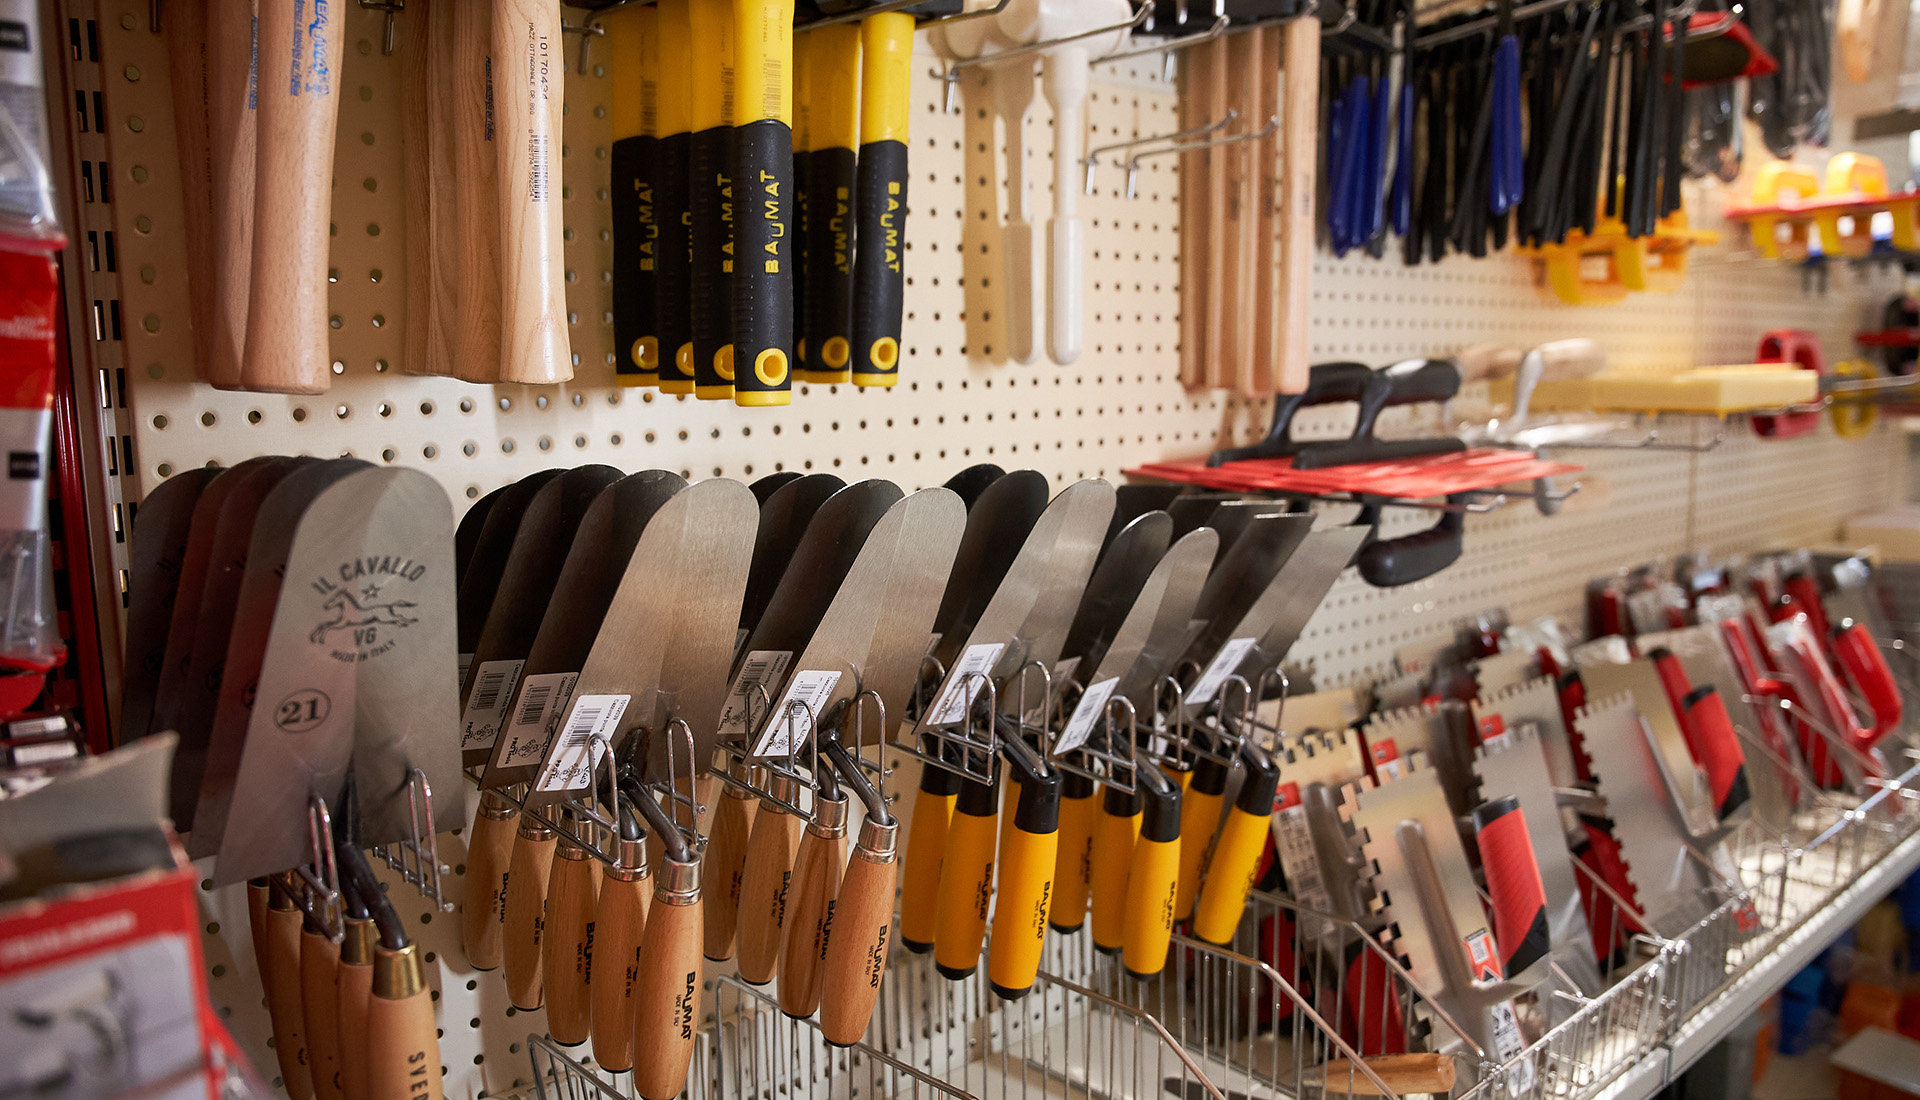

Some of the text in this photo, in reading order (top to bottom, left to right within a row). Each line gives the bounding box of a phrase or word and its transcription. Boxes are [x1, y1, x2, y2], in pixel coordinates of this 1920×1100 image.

[634, 178, 658, 271] BAUMAT
[717, 173, 734, 273] BAMAT
[760, 170, 784, 273] BAUMAT
[829, 186, 849, 275] BAUMAT
[880, 181, 900, 273] BAUMAT
[312, 556, 426, 595] IL CAVALLO
[330, 639, 396, 663] MADE IN ITALY
[354, 627, 377, 646] VG
[281, 698, 320, 725] 21
[777, 870, 791, 928] BAUMA
[979, 862, 992, 920] BAUMAT
[1037, 881, 1050, 939] BAUMAT
[584, 922, 595, 984] BAUMA
[820, 900, 836, 960] BAUMA
[870, 925, 888, 989] BAUMAT
[681, 971, 696, 1040] BAUMAT
